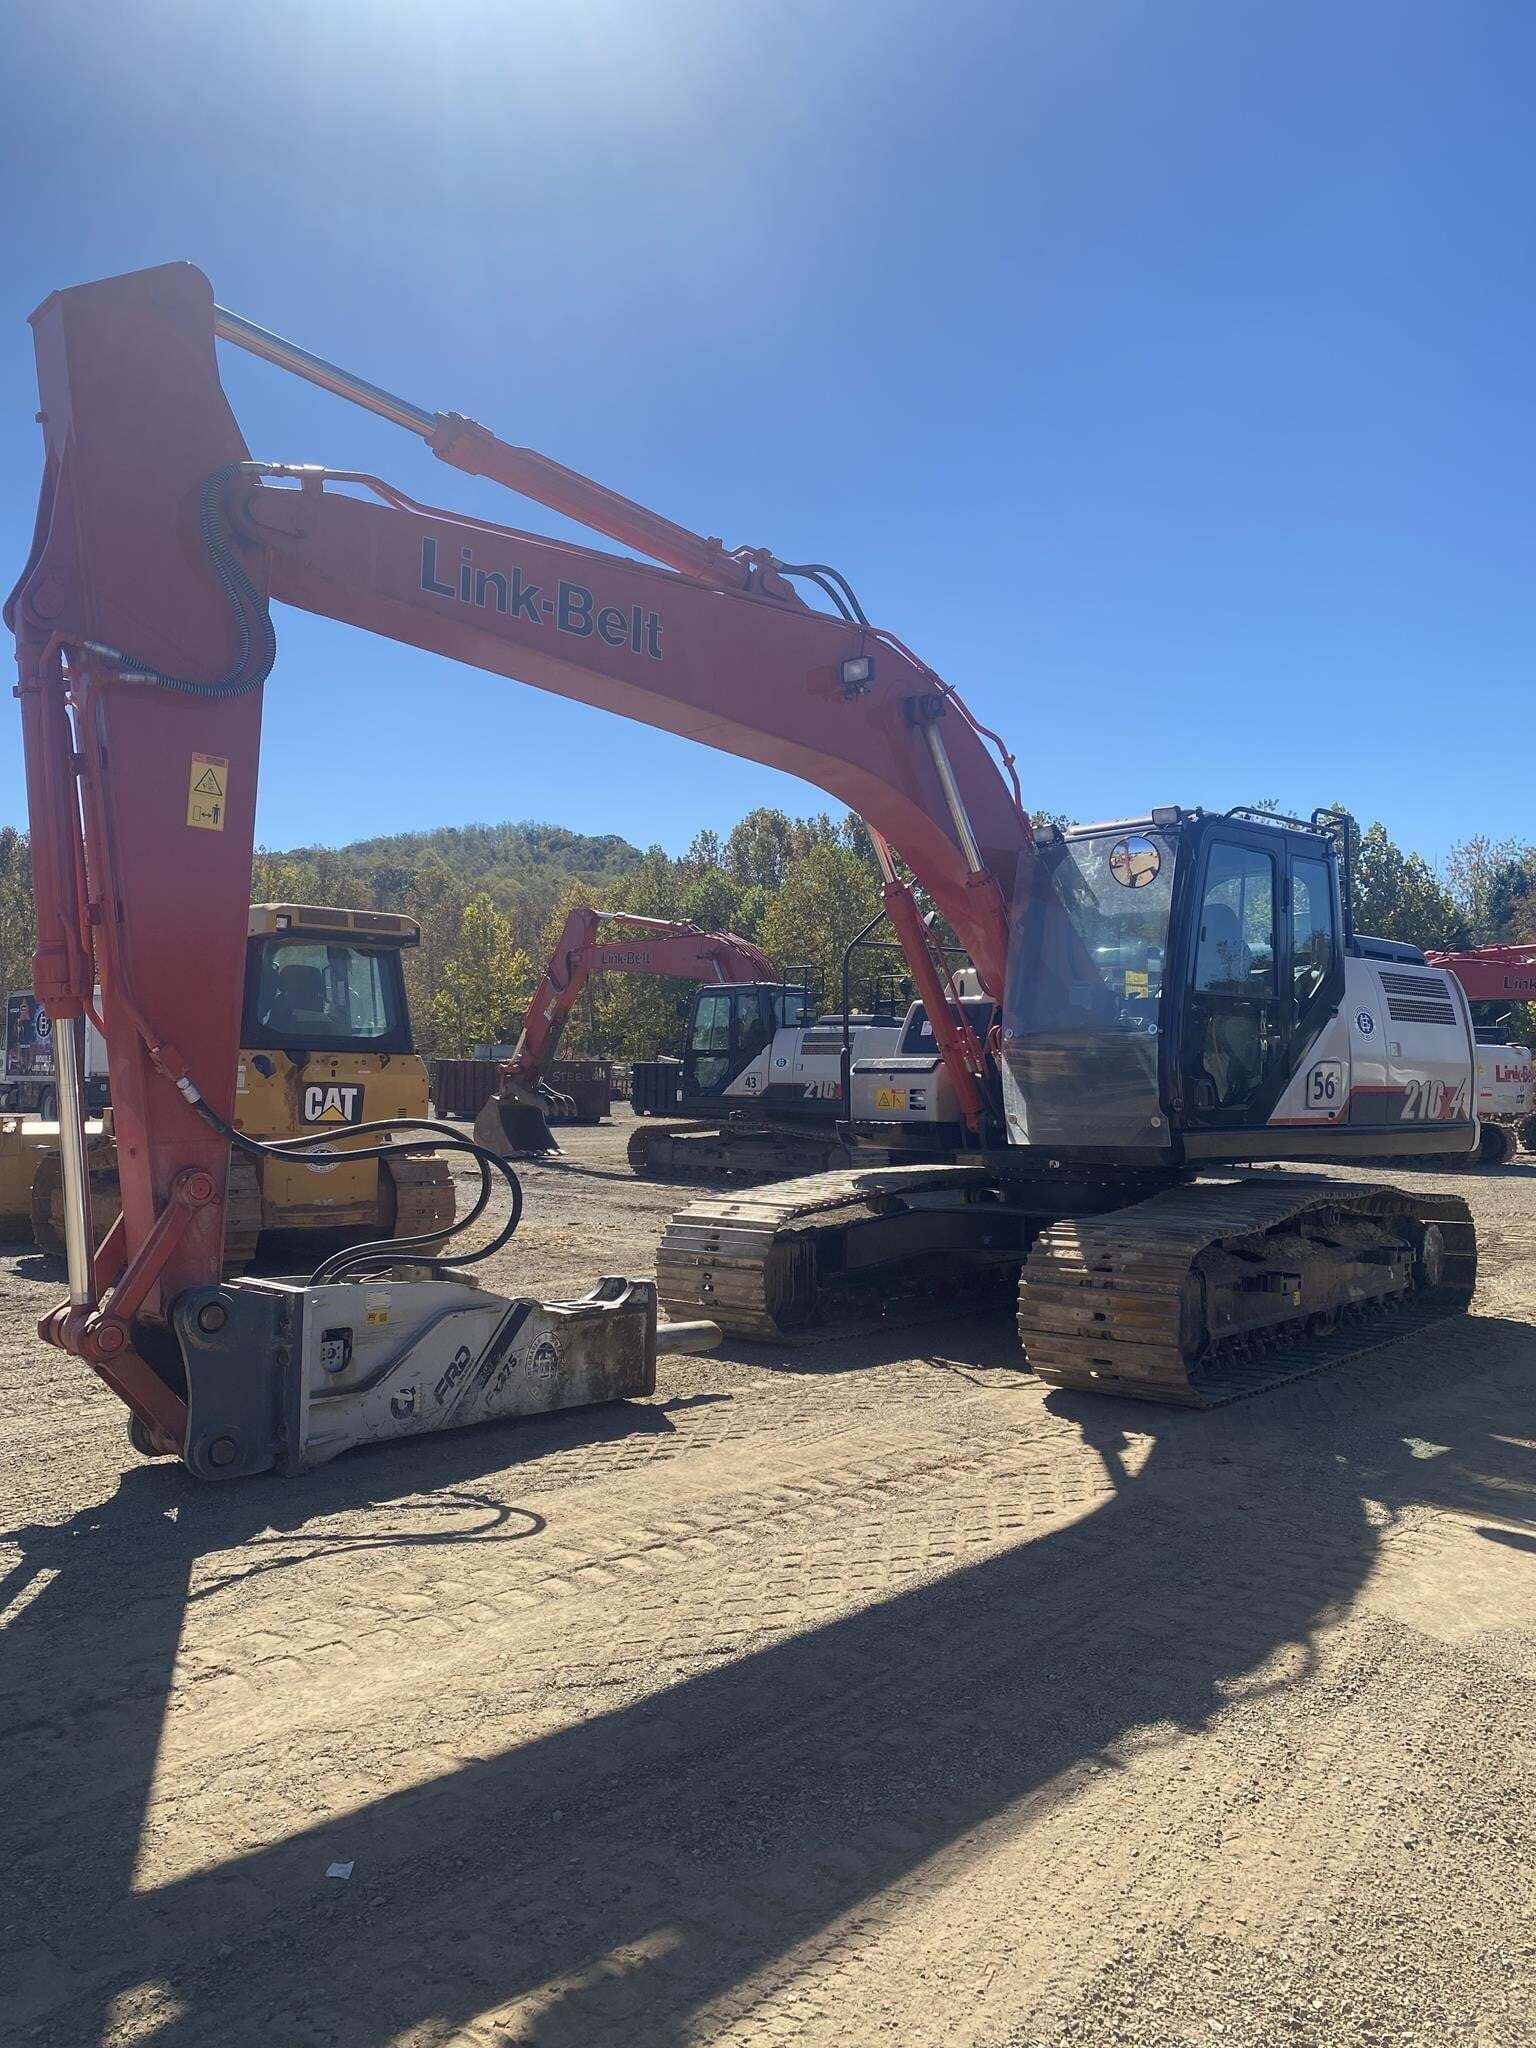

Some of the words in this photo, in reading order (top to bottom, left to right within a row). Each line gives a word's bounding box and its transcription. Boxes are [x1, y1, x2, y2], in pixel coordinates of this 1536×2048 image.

[420, 536, 664, 661] Link-Belt
[602, 951, 651, 965] Link-Belt
[745, 1077, 757, 1089] 43
[1314, 1071, 1335, 1099] 56
[305, 1086, 357, 1121] CAT
[433, 1345, 471, 1405] FRD
